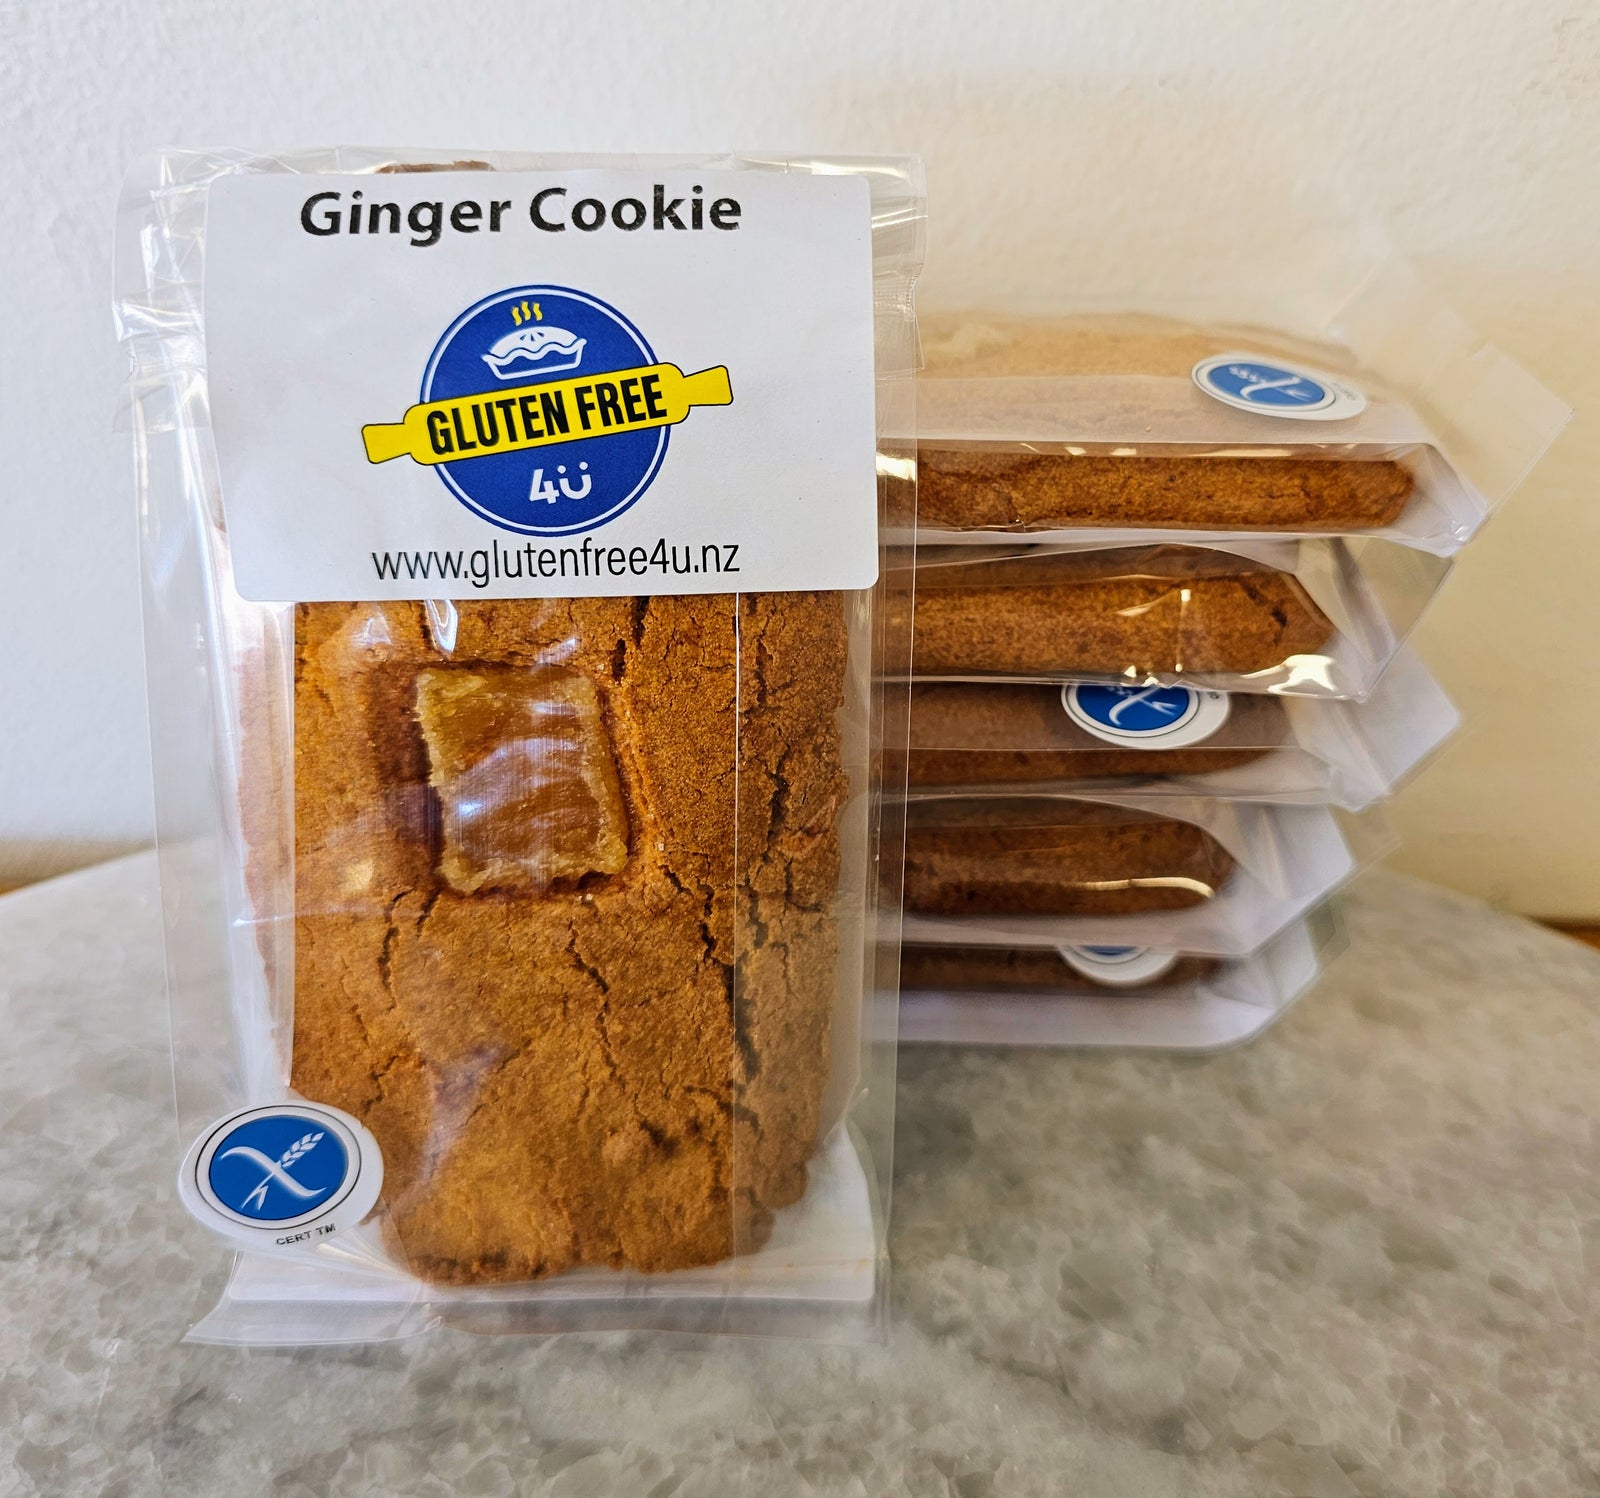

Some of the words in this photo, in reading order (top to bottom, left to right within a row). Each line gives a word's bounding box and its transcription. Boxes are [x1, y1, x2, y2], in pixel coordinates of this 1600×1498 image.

[300, 190, 511, 247] Ginger
[529, 184, 742, 232] Cookie
[427, 391, 569, 455] GLUTEN
[580, 373, 667, 430] FREE
[372, 537, 741, 588] www.glutenfree4u.nz
[276, 1231, 312, 1245] CERT
[316, 1224, 336, 1235] TM
